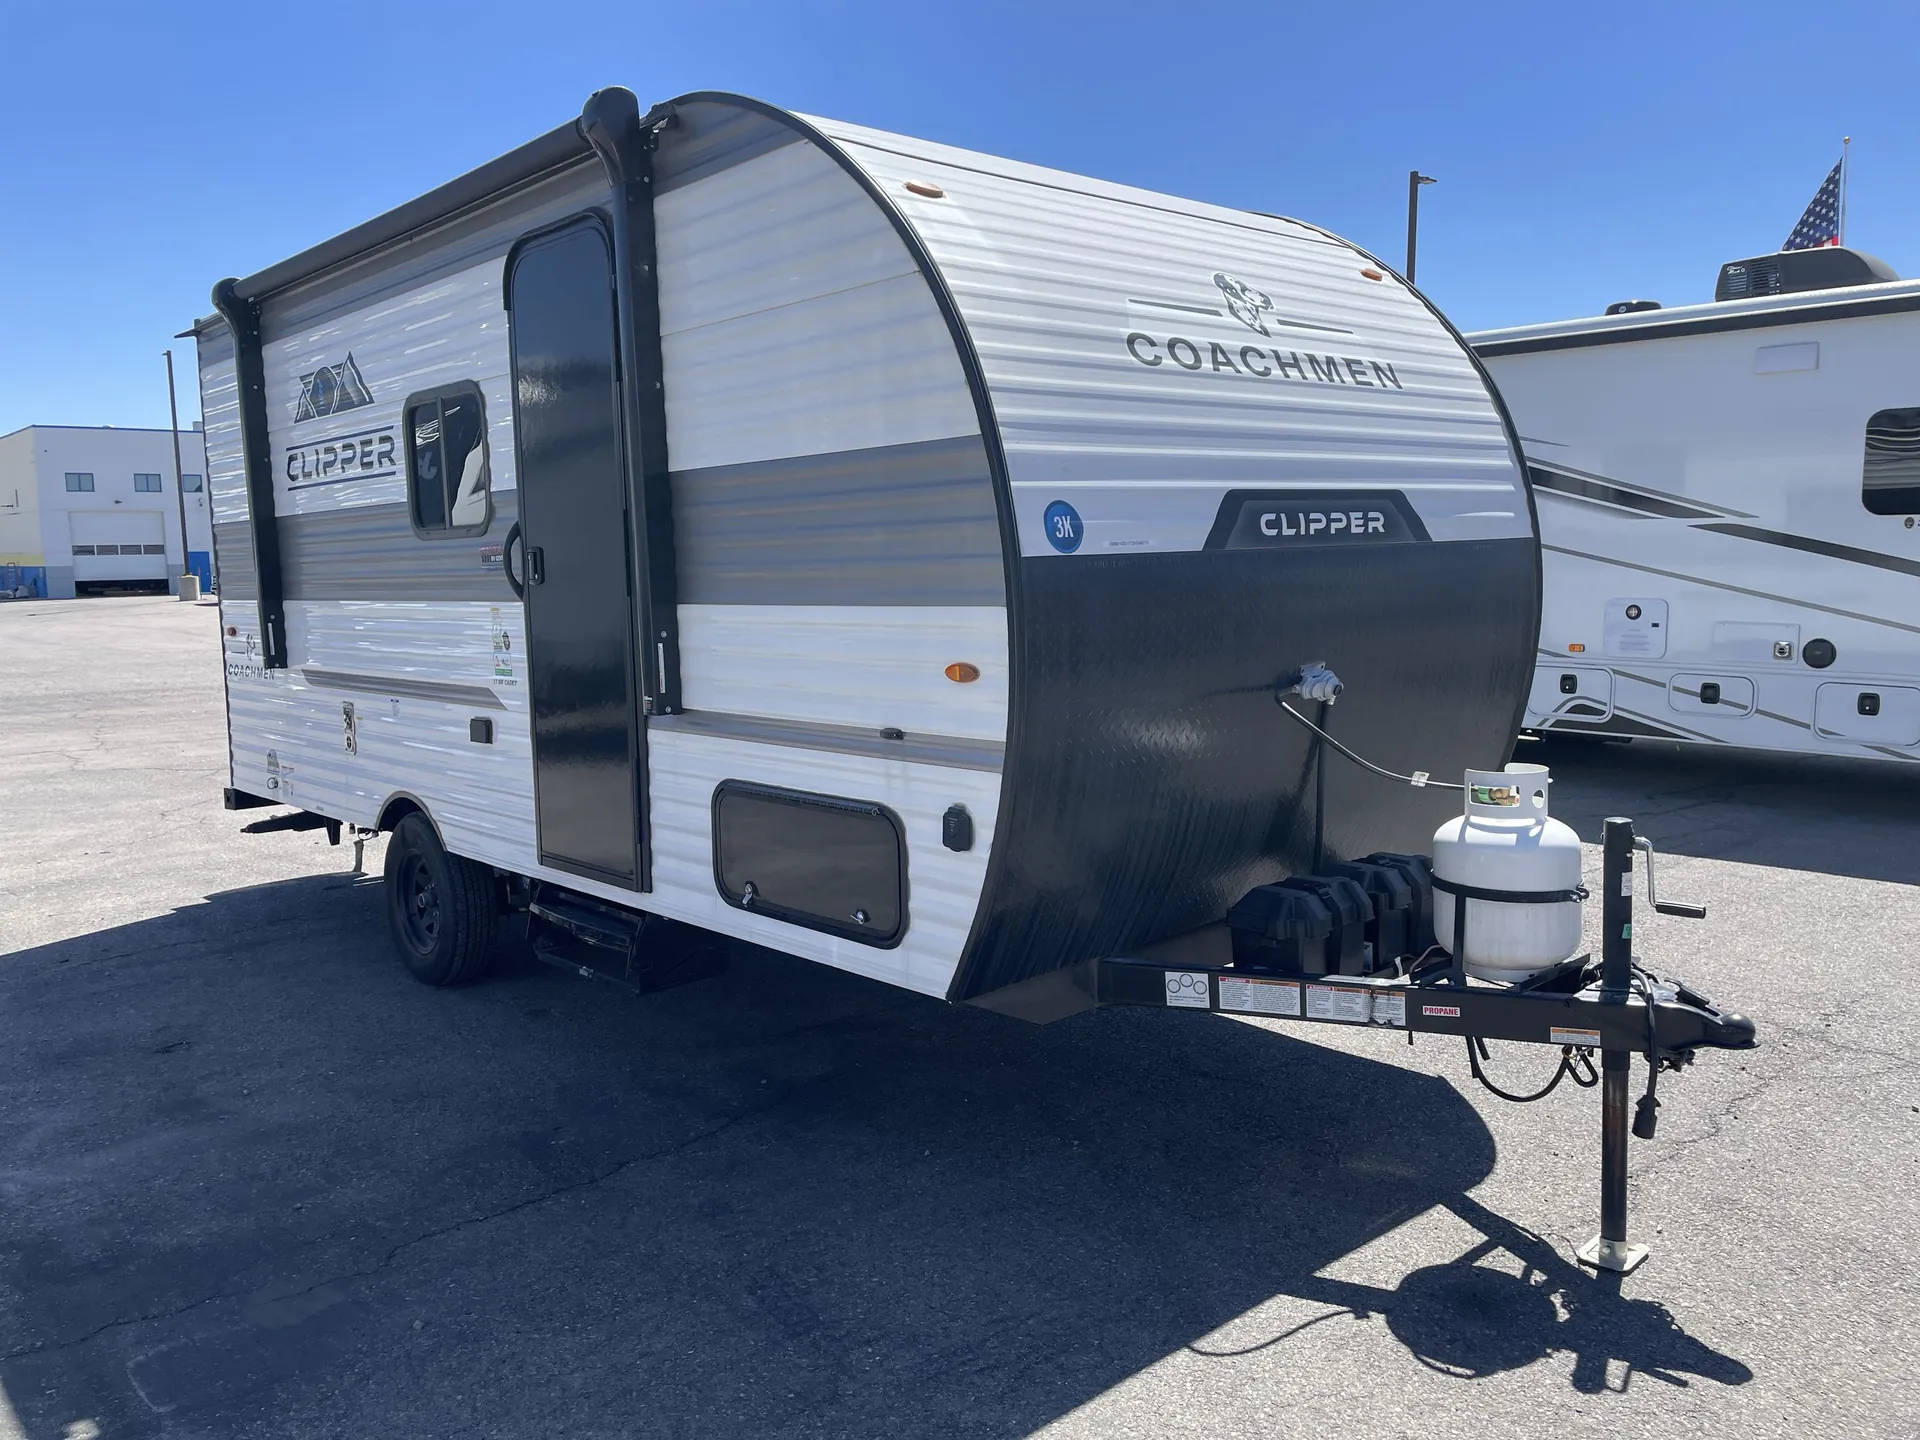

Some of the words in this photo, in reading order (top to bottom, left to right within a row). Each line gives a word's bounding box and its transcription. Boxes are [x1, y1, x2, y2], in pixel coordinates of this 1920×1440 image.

[1126, 332, 1404, 390] COACHMEN
[286, 434, 397, 482] CLIPPER
[1053, 515, 1075, 538] 3K
[1260, 511, 1386, 536] CLIPPER
[227, 663, 275, 680] COACHMEN
[1423, 1006, 1459, 1016] PROPANE
